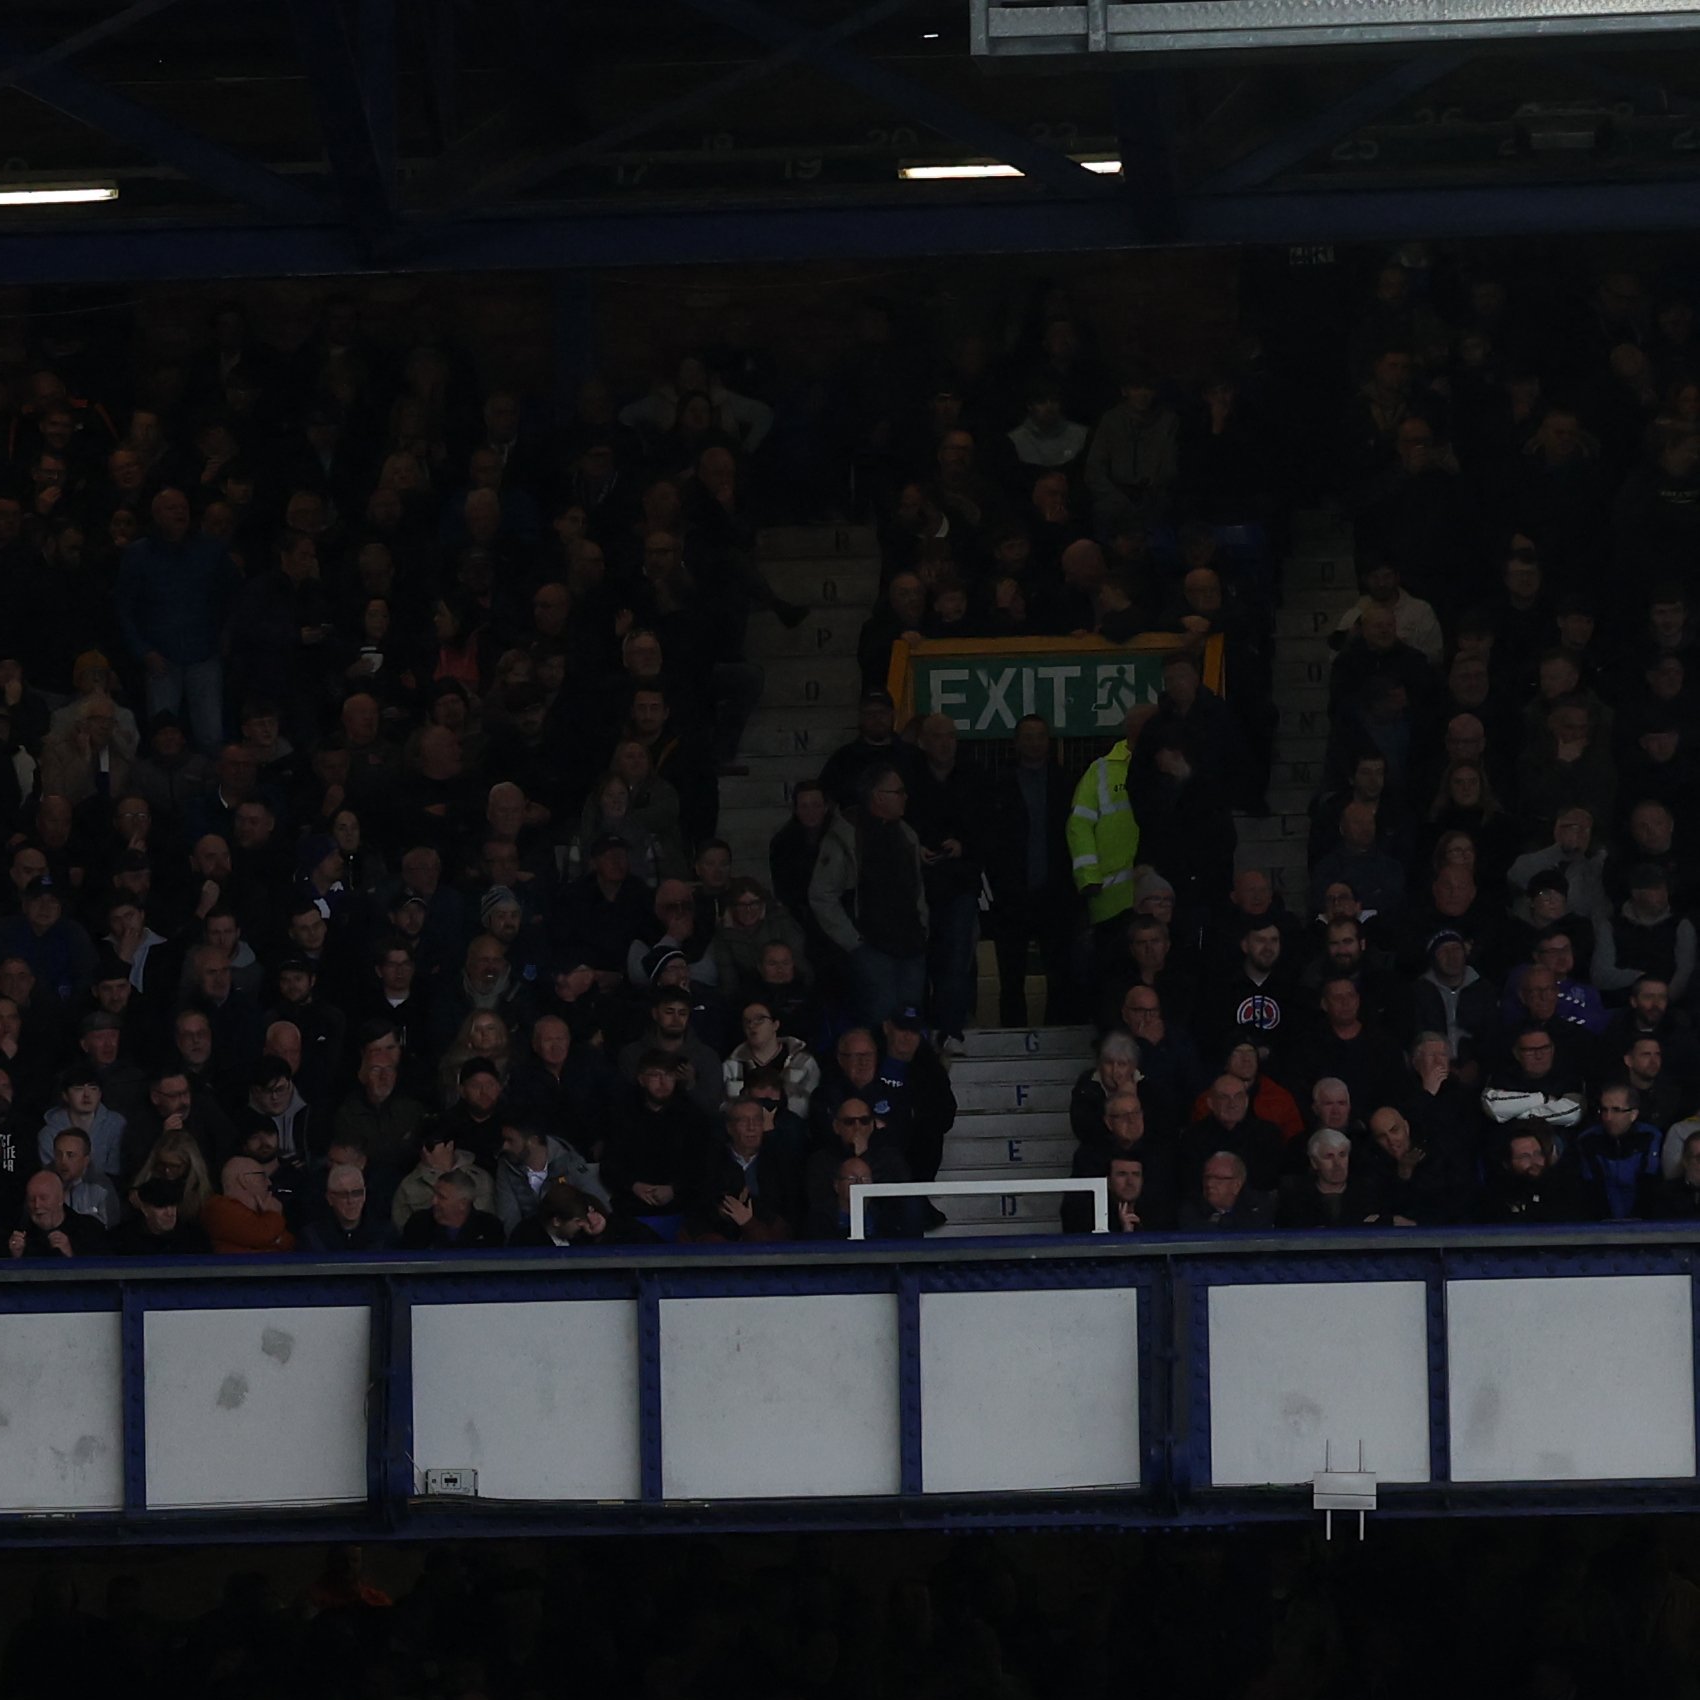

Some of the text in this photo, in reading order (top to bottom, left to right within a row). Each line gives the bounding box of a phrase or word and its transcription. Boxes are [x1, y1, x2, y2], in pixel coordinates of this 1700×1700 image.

[929, 665, 1081, 731] EXIT
[1016, 1084, 1029, 1106] F
[1009, 1139, 1022, 1162] E
